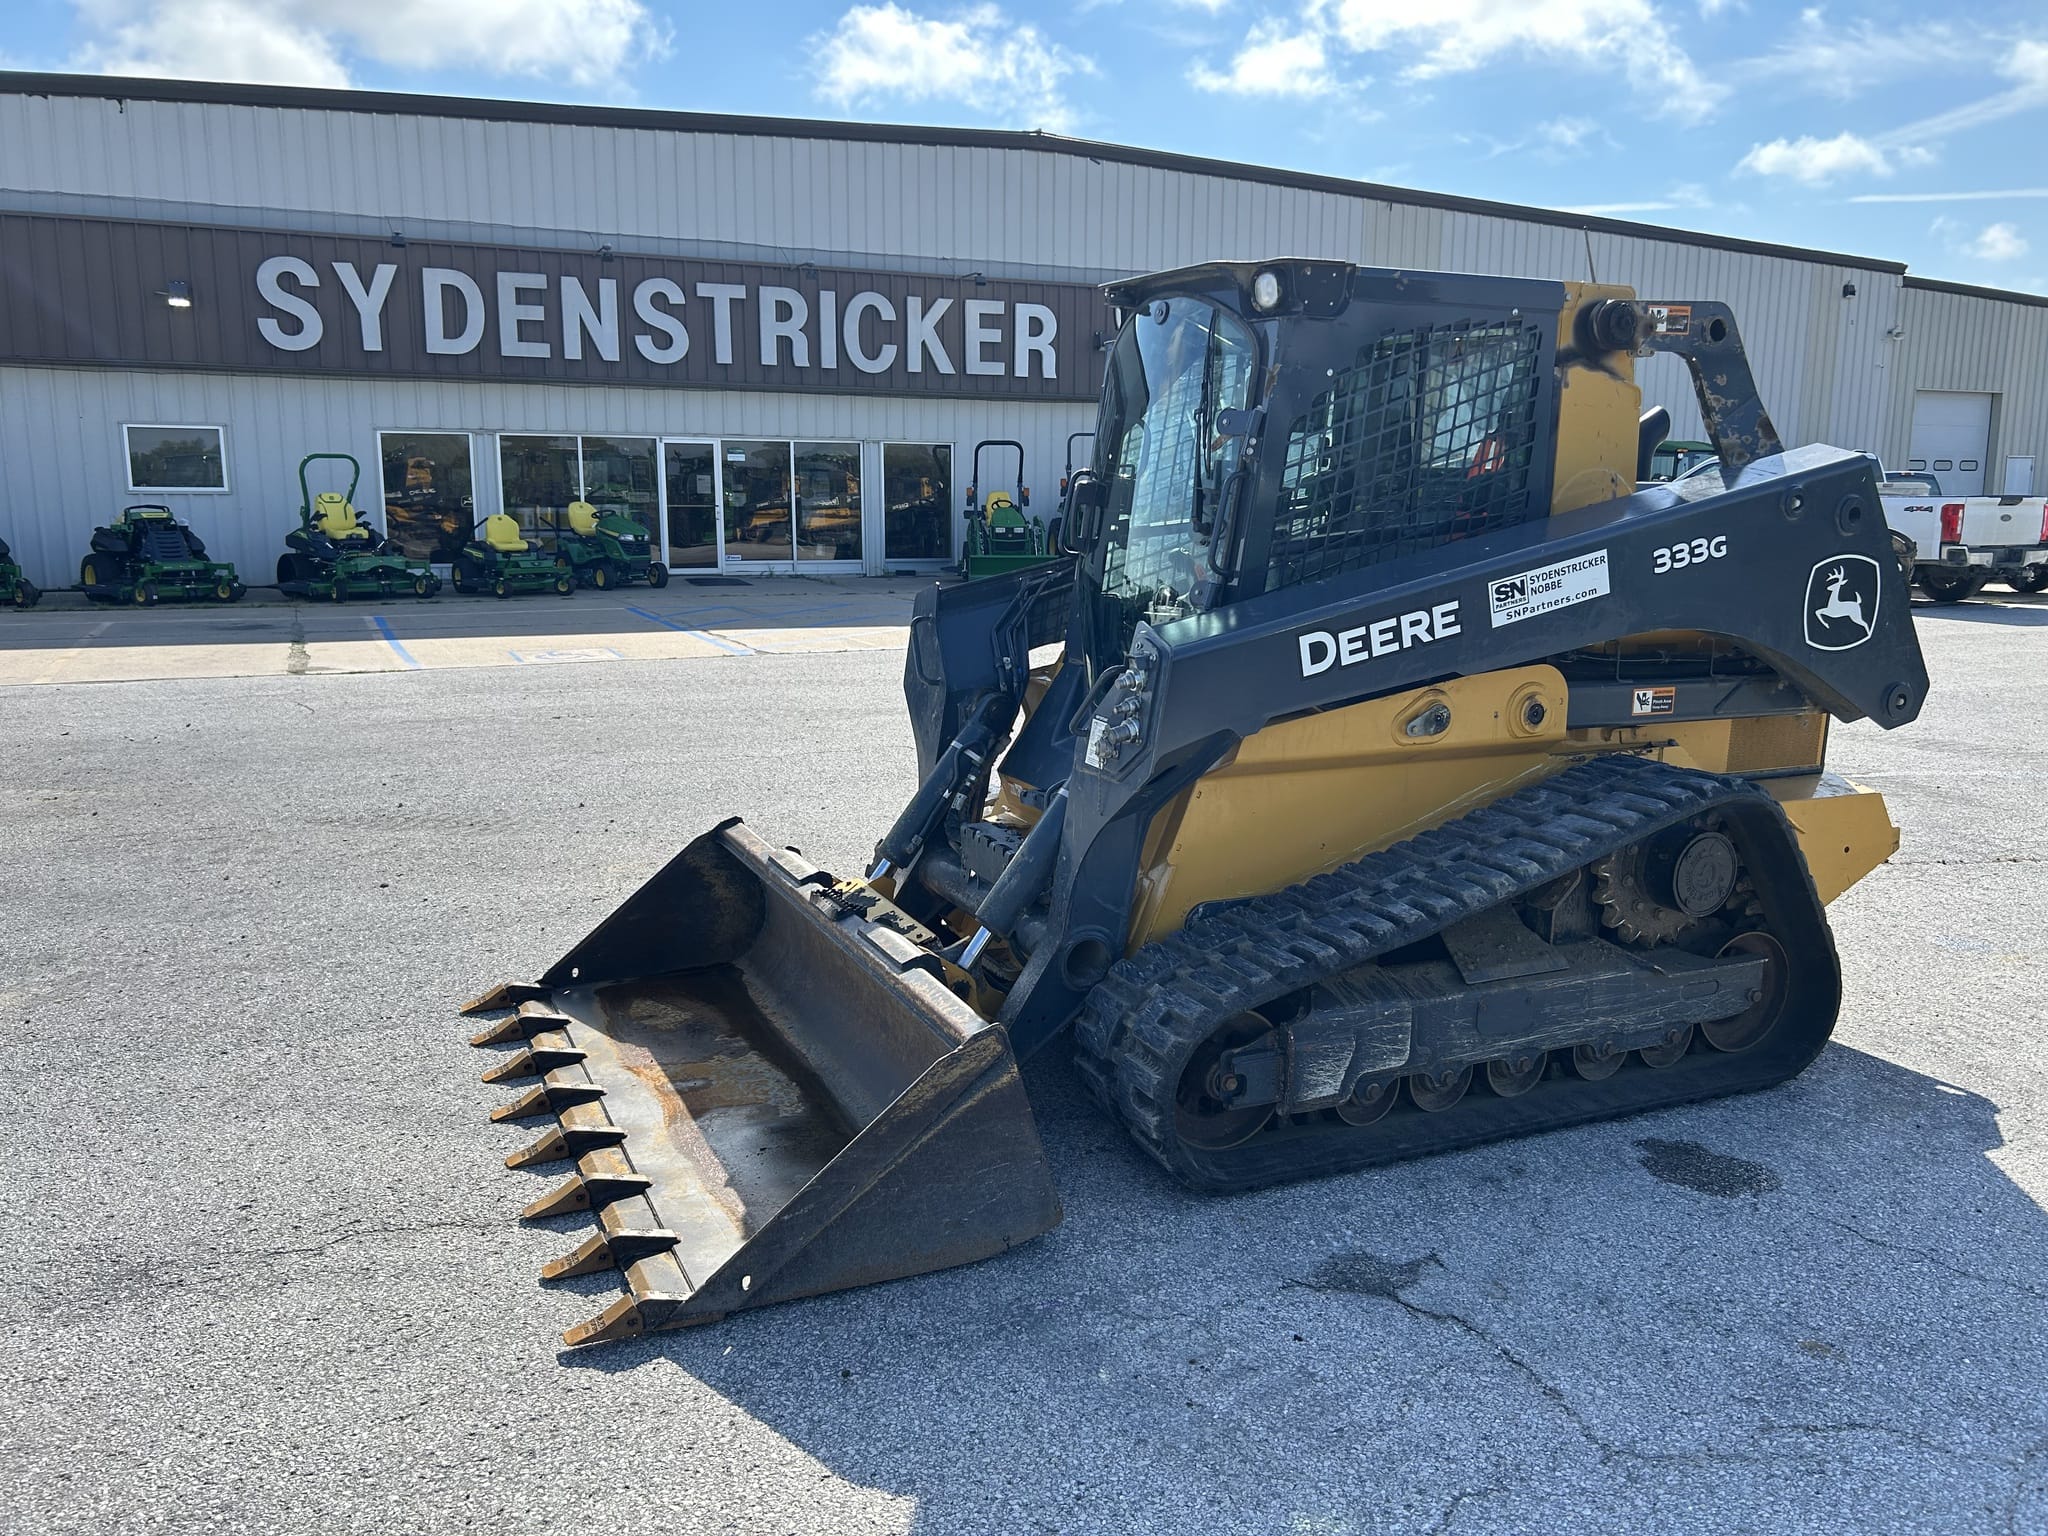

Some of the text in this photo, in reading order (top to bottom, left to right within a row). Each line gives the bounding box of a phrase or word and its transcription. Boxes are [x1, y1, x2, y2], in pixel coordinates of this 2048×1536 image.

[256, 256, 1058, 379] SYDENSTRICKER
[1529, 555, 1606, 585] SYDENSTRICKER
[1653, 535, 1728, 574] 333G
[1495, 596, 1527, 610] PARTNERS
[1506, 588, 1598, 621] SNPartners.com
[1530, 579, 1563, 597] NOBBE
[1298, 600, 1462, 678] DEERE
